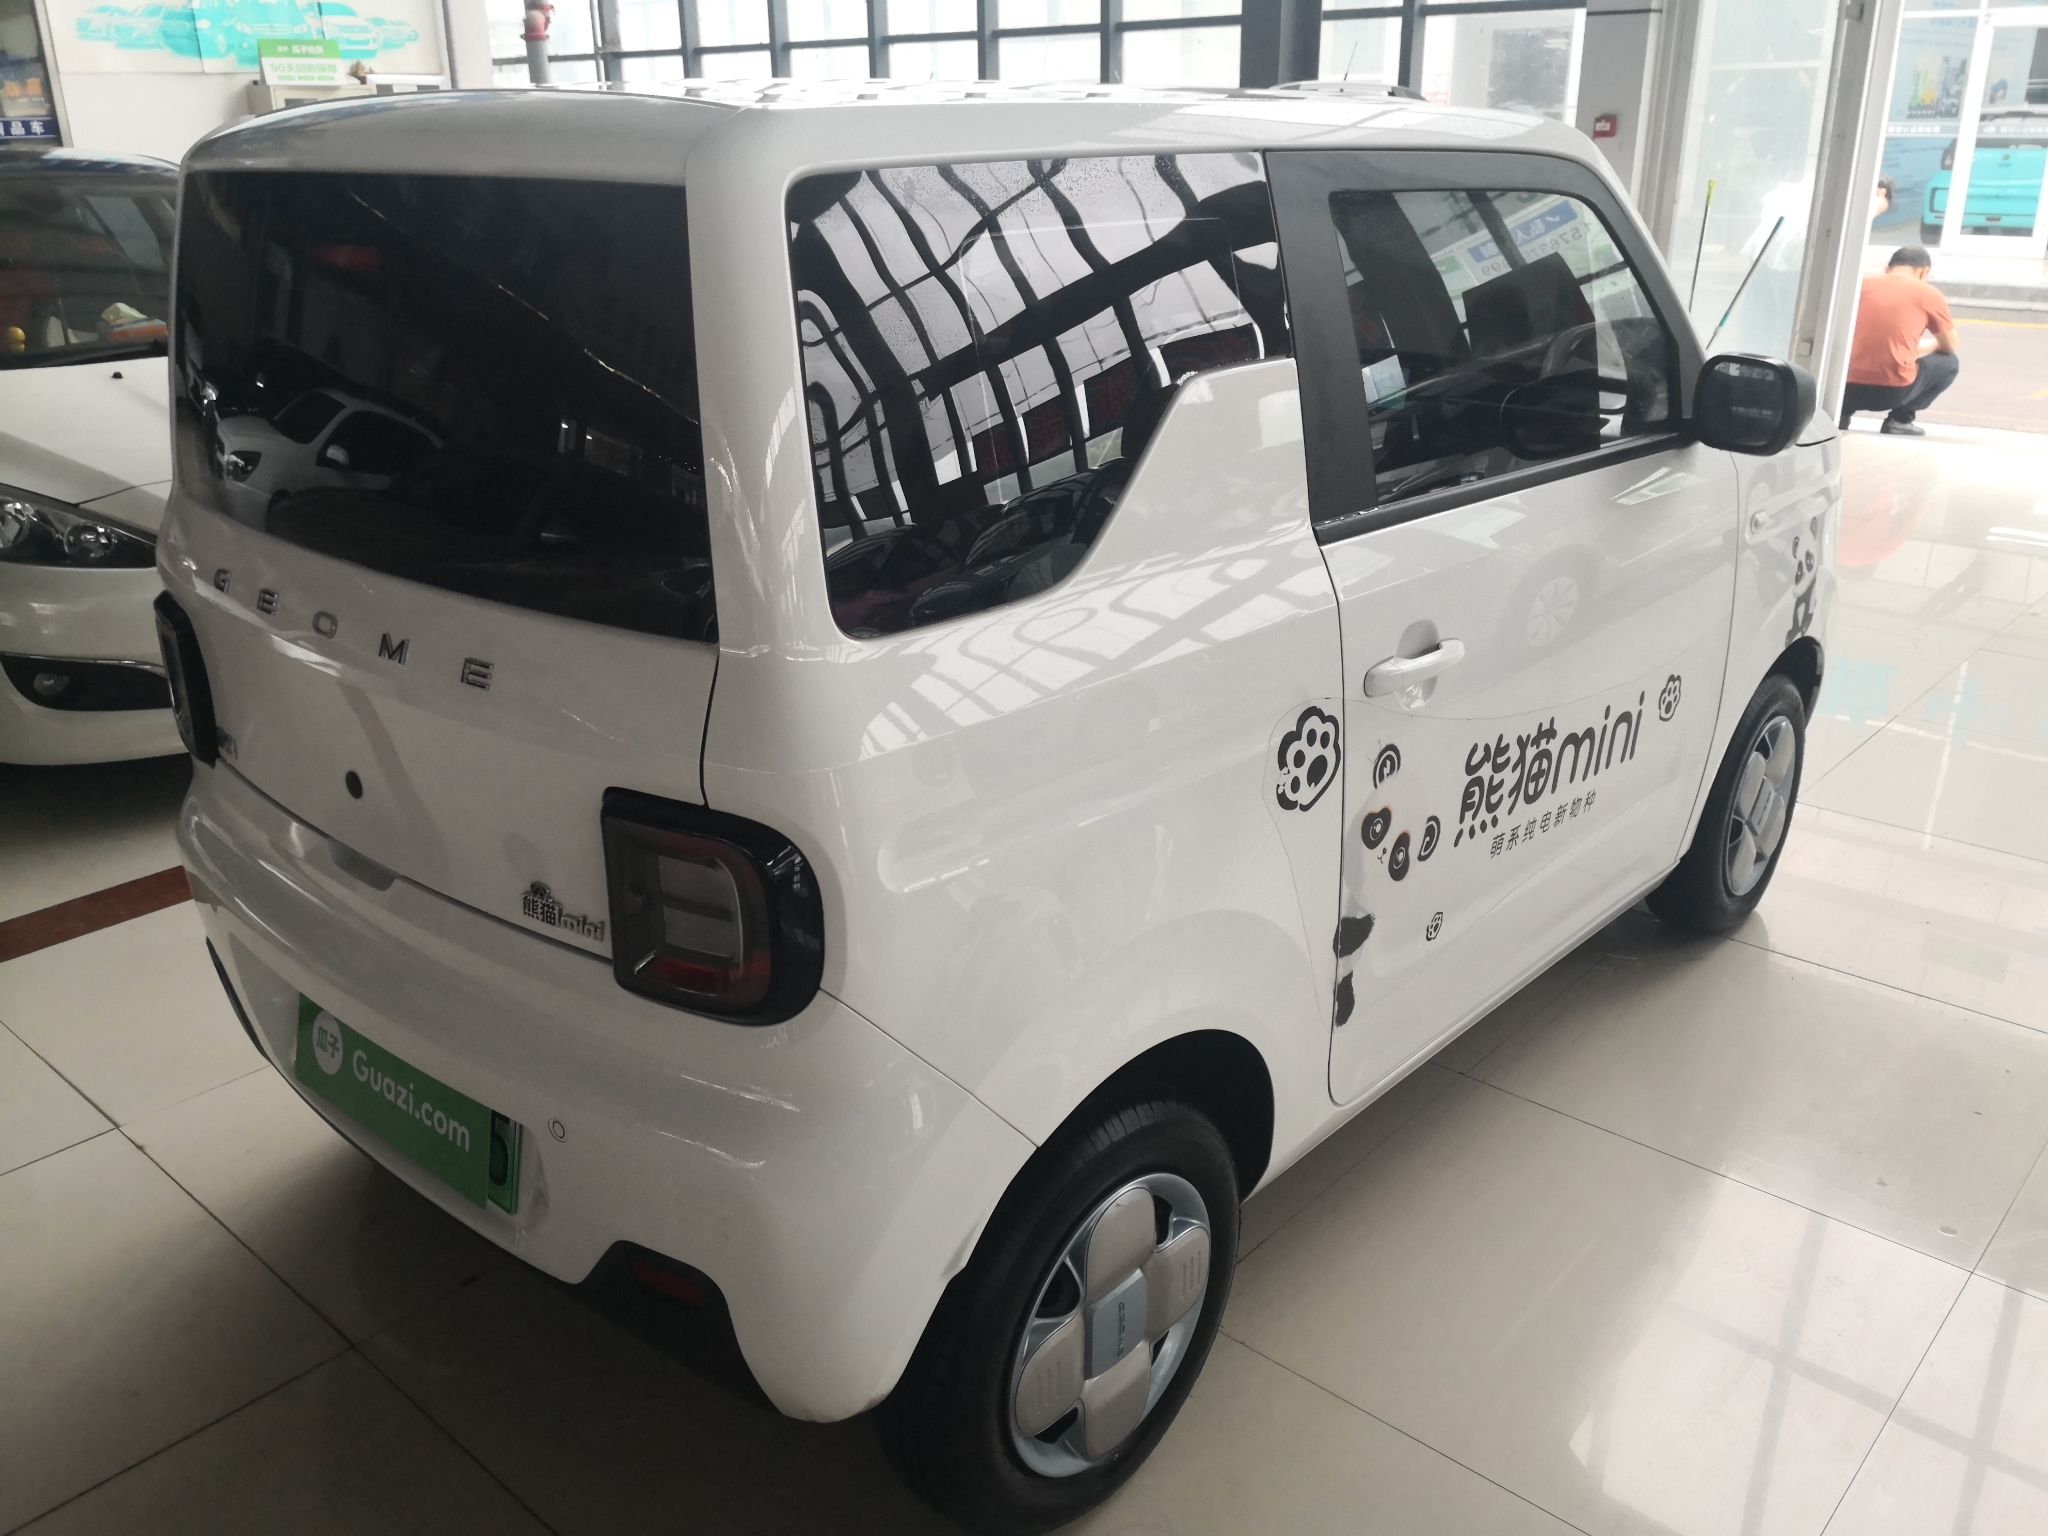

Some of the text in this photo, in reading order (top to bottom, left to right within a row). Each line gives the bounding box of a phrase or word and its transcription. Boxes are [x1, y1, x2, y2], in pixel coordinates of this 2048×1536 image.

[213, 567, 495, 691] GEOME
[315, 1025, 341, 1061] 瓜子
[352, 1049, 471, 1152] Guazi.com
